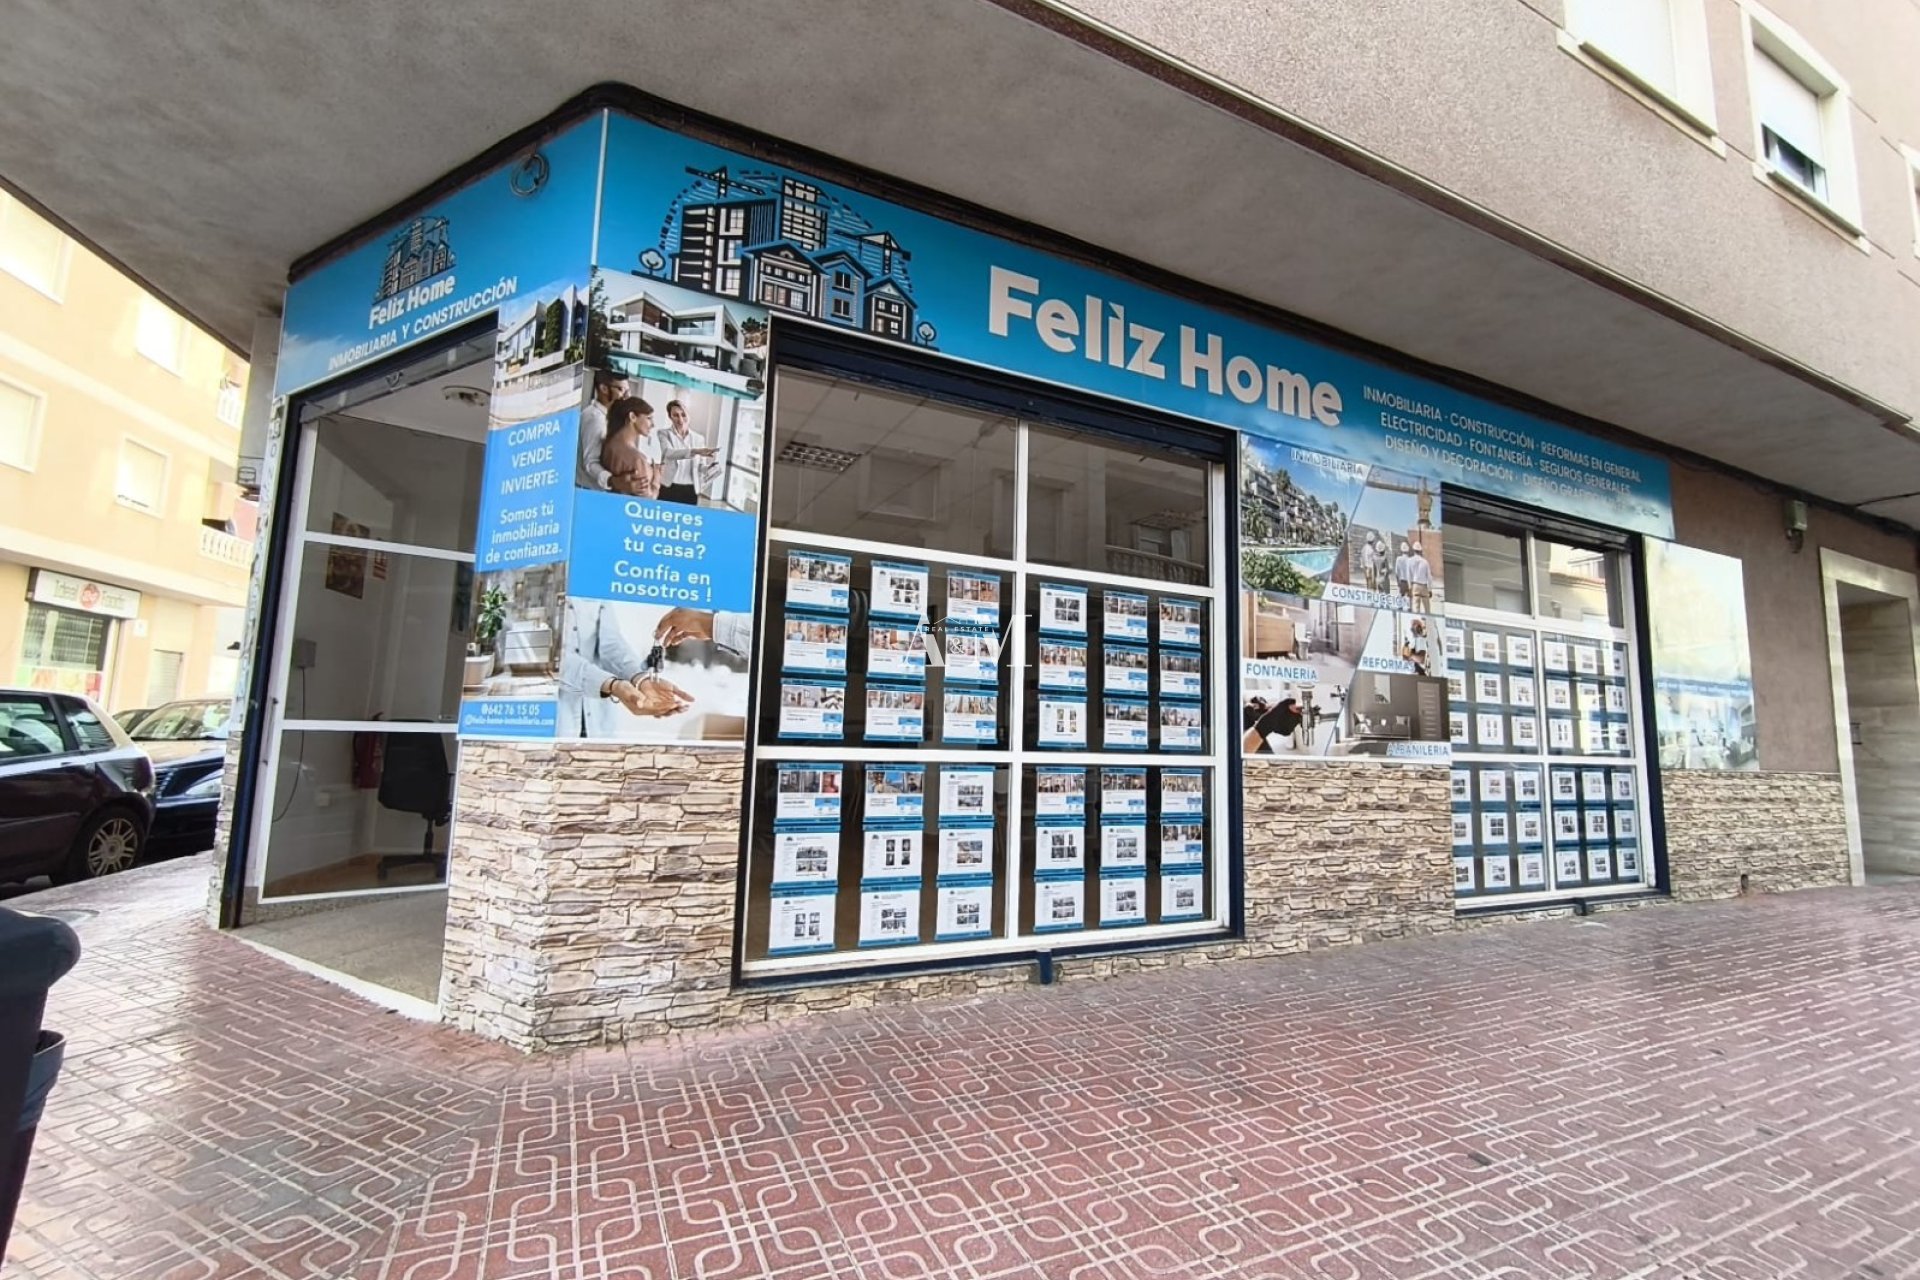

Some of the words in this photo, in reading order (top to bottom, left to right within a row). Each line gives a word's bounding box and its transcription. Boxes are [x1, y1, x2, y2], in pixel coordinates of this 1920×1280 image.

[368, 297, 405, 330] Feliz
[406, 275, 456, 312] Home
[328, 329, 398, 371] INMOBILIARIA
[401, 322, 411, 340] Y
[413, 275, 518, 335] CONSTRUCCIÓN
[989, 265, 1166, 380] Feliz
[1180, 324, 1343, 428] Home
[508, 420, 561, 447] COMPRA
[1363, 384, 1443, 422] INMOBILIARIA
[1451, 412, 1535, 450] CONSTRUCCIÓN
[1540, 441, 1590, 468] REFORMAS
[1591, 457, 1603, 472] EN
[1603, 462, 1642, 484] GENERAL
[511, 445, 554, 469] VENDE
[1290, 448, 1363, 476] INMOBILIARIA
[1381, 412, 1463, 447] ELECTRICIDAD
[1469, 438, 1534, 468] FONTANERÍA
[1539, 459, 1583, 483] SEGUROS
[1583, 472, 1632, 495] GENERALES
[1385, 434, 1429, 460] DISEÑO
[1431, 448, 1441, 461] Y
[1443, 452, 1514, 482] DECORACIÓN
[501, 469, 560, 495] INVIERTE:
[500, 506, 538, 525] Somos
[541, 499, 555, 516] tú
[624, 501, 704, 527] Quieres
[491, 520, 560, 545] inmobiliaria
[631, 523, 702, 543] vender
[485, 546, 501, 564] de
[504, 541, 563, 563] confianza.
[623, 536, 645, 553] tu
[652, 542, 707, 560] casa?
[614, 560, 681, 583] Confía
[687, 572, 711, 585] en
[610, 580, 700, 602] nosotros
[1361, 656, 1416, 671] REFORMAS
[504, 704, 515, 715] 76
[517, 704, 527, 715] 15
[529, 704, 541, 716] 05
